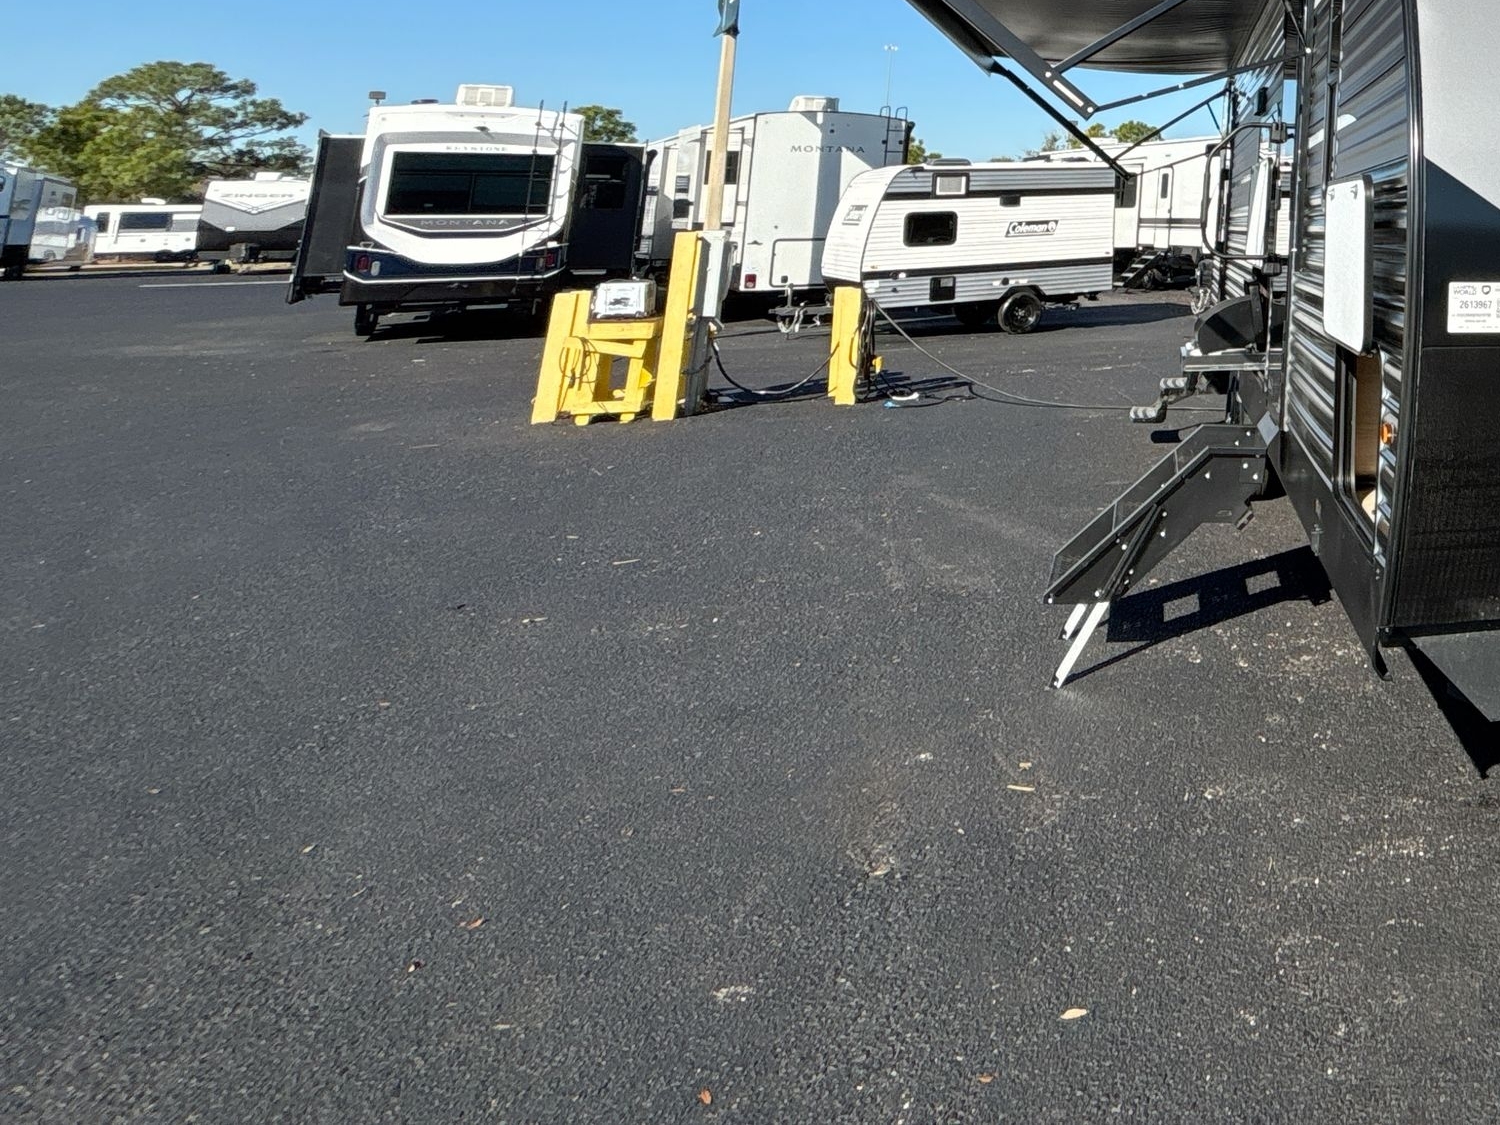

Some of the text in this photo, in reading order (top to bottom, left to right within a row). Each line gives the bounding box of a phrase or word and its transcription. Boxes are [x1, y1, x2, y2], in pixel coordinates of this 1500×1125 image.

[790, 145, 865, 153] MONTANA
[1009, 222, 1048, 234] Coleman
[1459, 300, 1493, 309] 2613967
